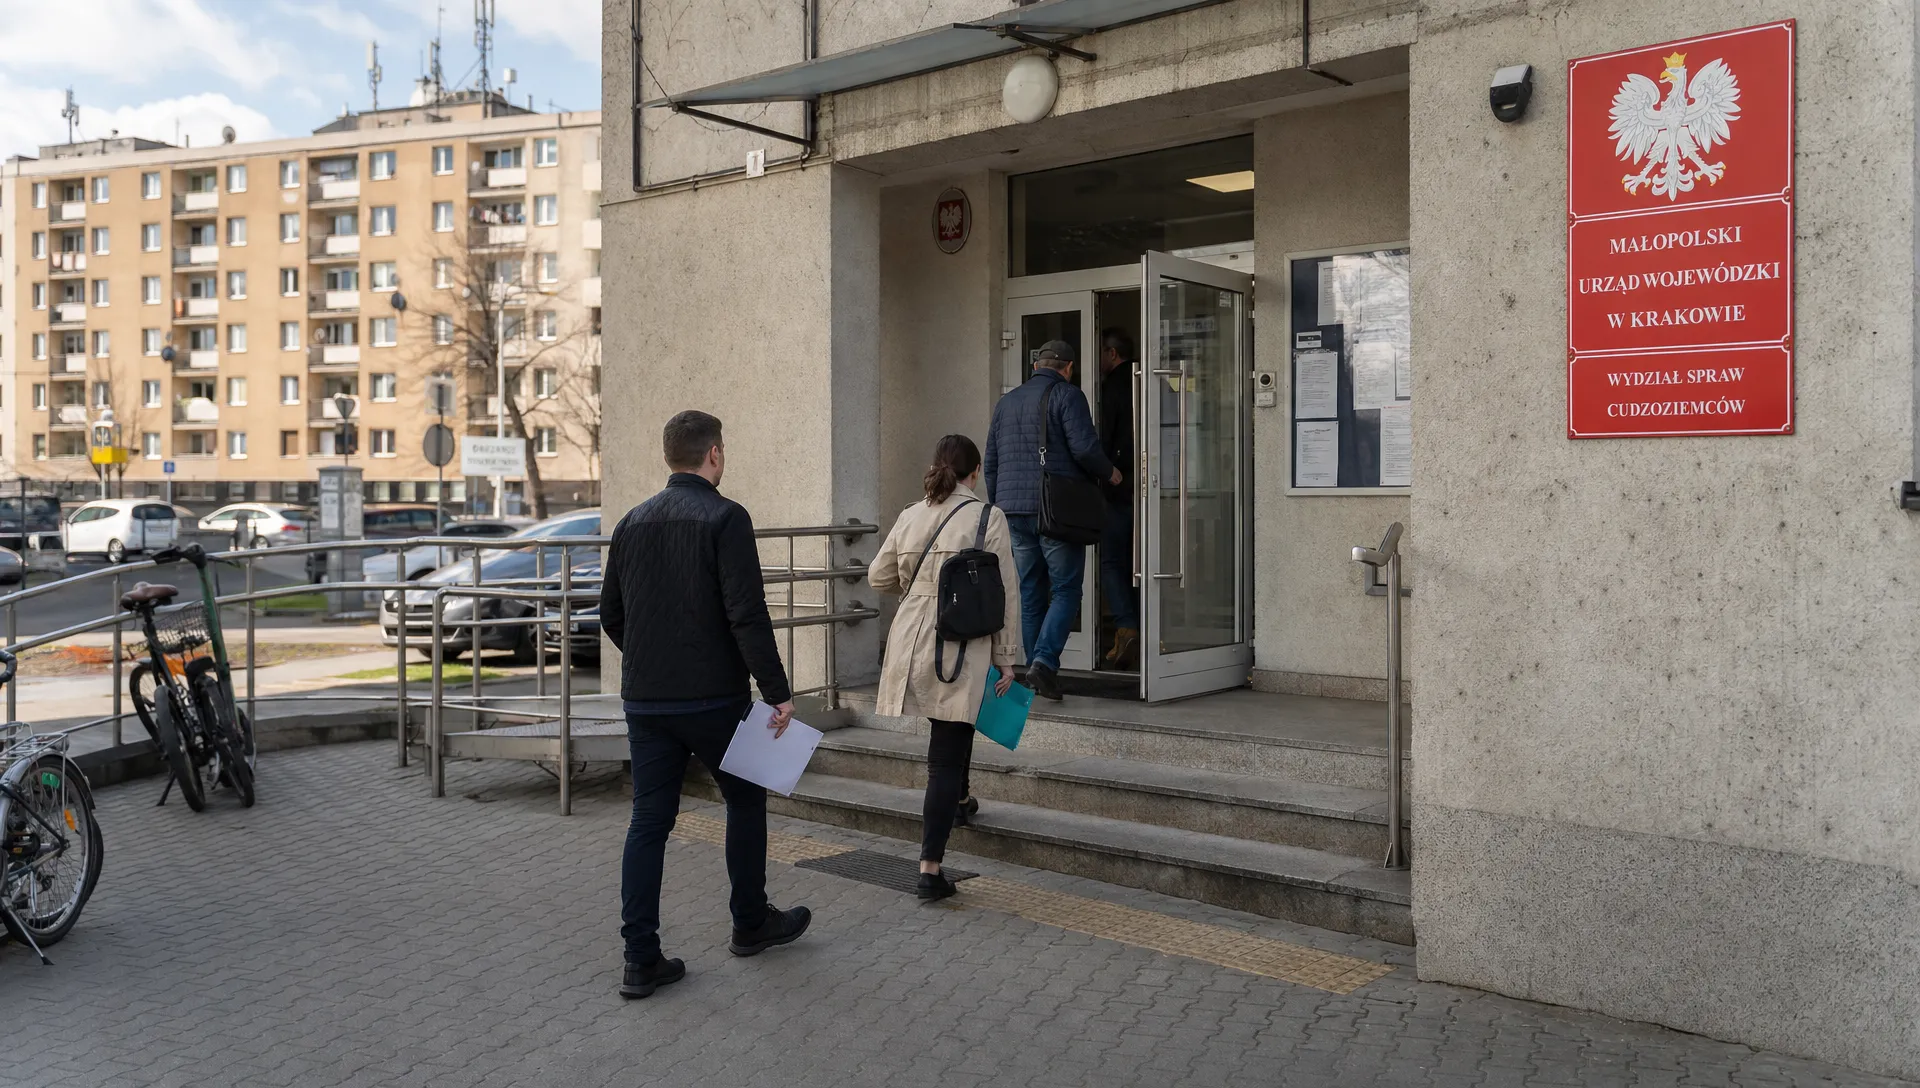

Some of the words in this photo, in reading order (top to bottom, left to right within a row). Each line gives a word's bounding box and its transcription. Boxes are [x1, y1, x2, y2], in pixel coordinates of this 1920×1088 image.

[1609, 225, 1742, 255] MAŁOPOLSKI
[1579, 275, 1640, 295] URZĄD
[1642, 261, 1781, 289] WOJEWÓDZKI
[1607, 312, 1625, 329] W
[1630, 304, 1746, 328] KRAKOWIE
[1607, 370, 1683, 387] WYDZIAŁ
[1687, 367, 1745, 384] SPRAW
[1607, 396, 1746, 418] CUDZOZIEMCÓW
